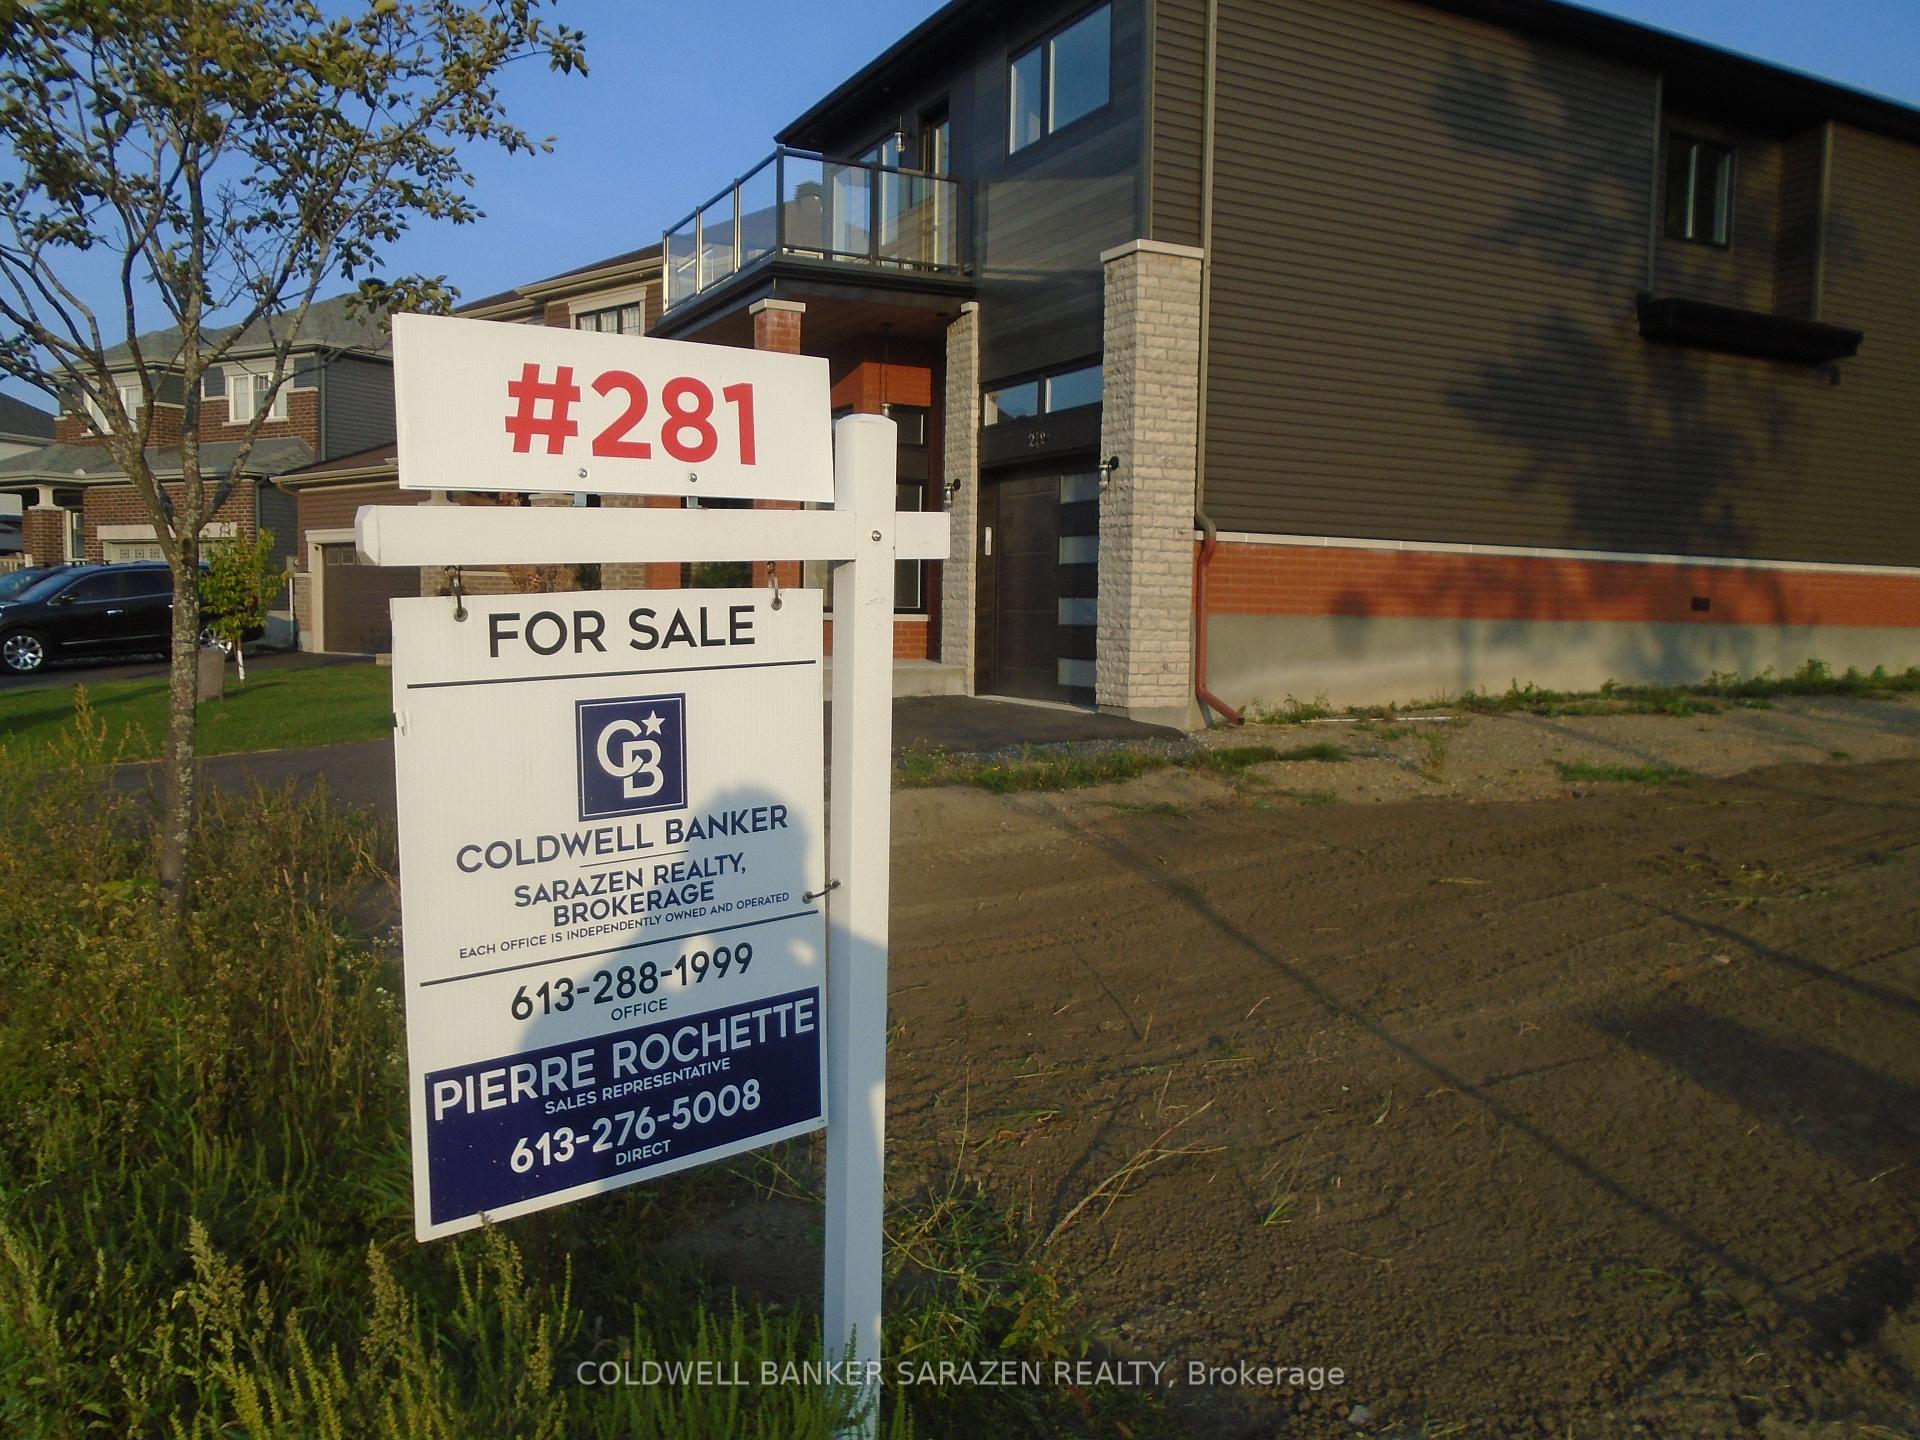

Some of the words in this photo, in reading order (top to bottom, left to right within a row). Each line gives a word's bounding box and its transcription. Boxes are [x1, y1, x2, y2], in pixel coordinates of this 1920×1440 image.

[505, 363, 756, 466] #281
[488, 610, 607, 658] FOR
[629, 604, 756, 651] SALE
[456, 823, 654, 873] COLDWELL
[665, 804, 789, 845] BANKER
[514, 868, 643, 907] SARAZEN
[654, 852, 746, 885] REALTY,
[553, 880, 715, 927] BROKERAGE
[459, 943, 496, 959] EACH
[500, 934, 547, 952] OFFICE
[551, 932, 563, 943] IS
[567, 915, 662, 940] INDEPENDENTLY
[665, 906, 707, 923] OWNED
[710, 902, 733, 915] AND
[736, 892, 790, 910] OPERATED
[511, 942, 753, 1021] 613-288-1999
[611, 998, 668, 1021] OFFICE
[434, 1048, 596, 1121] PIERRE
[612, 997, 815, 1079] ROCHETTE
[545, 1091, 597, 1115] SALES
[602, 1057, 731, 1099] REPRESENTATIVE
[510, 1078, 761, 1174] 613-276-5008
[615, 1139, 672, 1166] DIRECT
